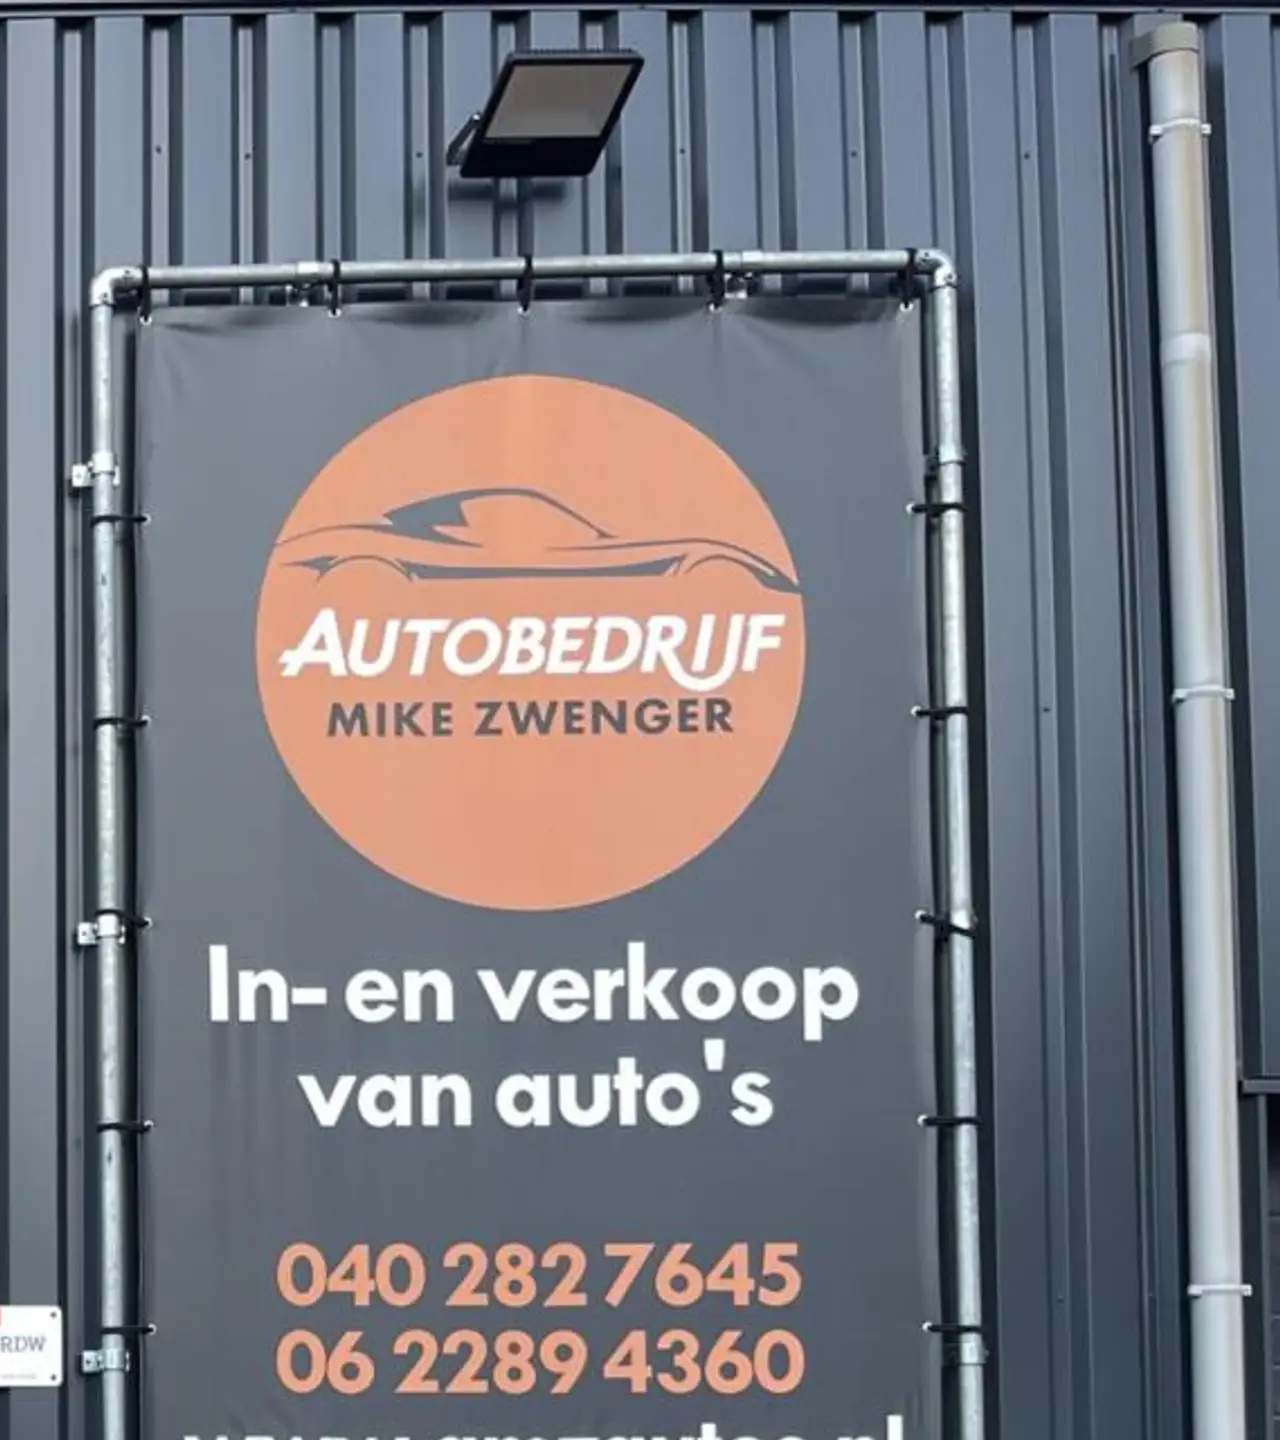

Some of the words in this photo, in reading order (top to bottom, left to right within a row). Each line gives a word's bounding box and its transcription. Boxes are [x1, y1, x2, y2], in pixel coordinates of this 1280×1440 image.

[280, 608, 786, 693] AUTOBEDRIJF
[326, 701, 453, 738] MIKE
[474, 697, 734, 737] ZWENGER
[208, 944, 328, 1022] In-
[345, 968, 455, 1022] en
[477, 941, 860, 1041] verkoop
[298, 1074, 473, 1127] van
[496, 1038, 774, 1127] auto's
[276, 1243, 426, 1307] 040
[444, 1243, 586, 1307] 282
[605, 1242, 802, 1307] 7645
[0, 1334, 47, 1354] RDW
[276, 1330, 375, 1394] 06
[393, 1329, 588, 1395] 2289
[604, 1330, 806, 1394] 4360
